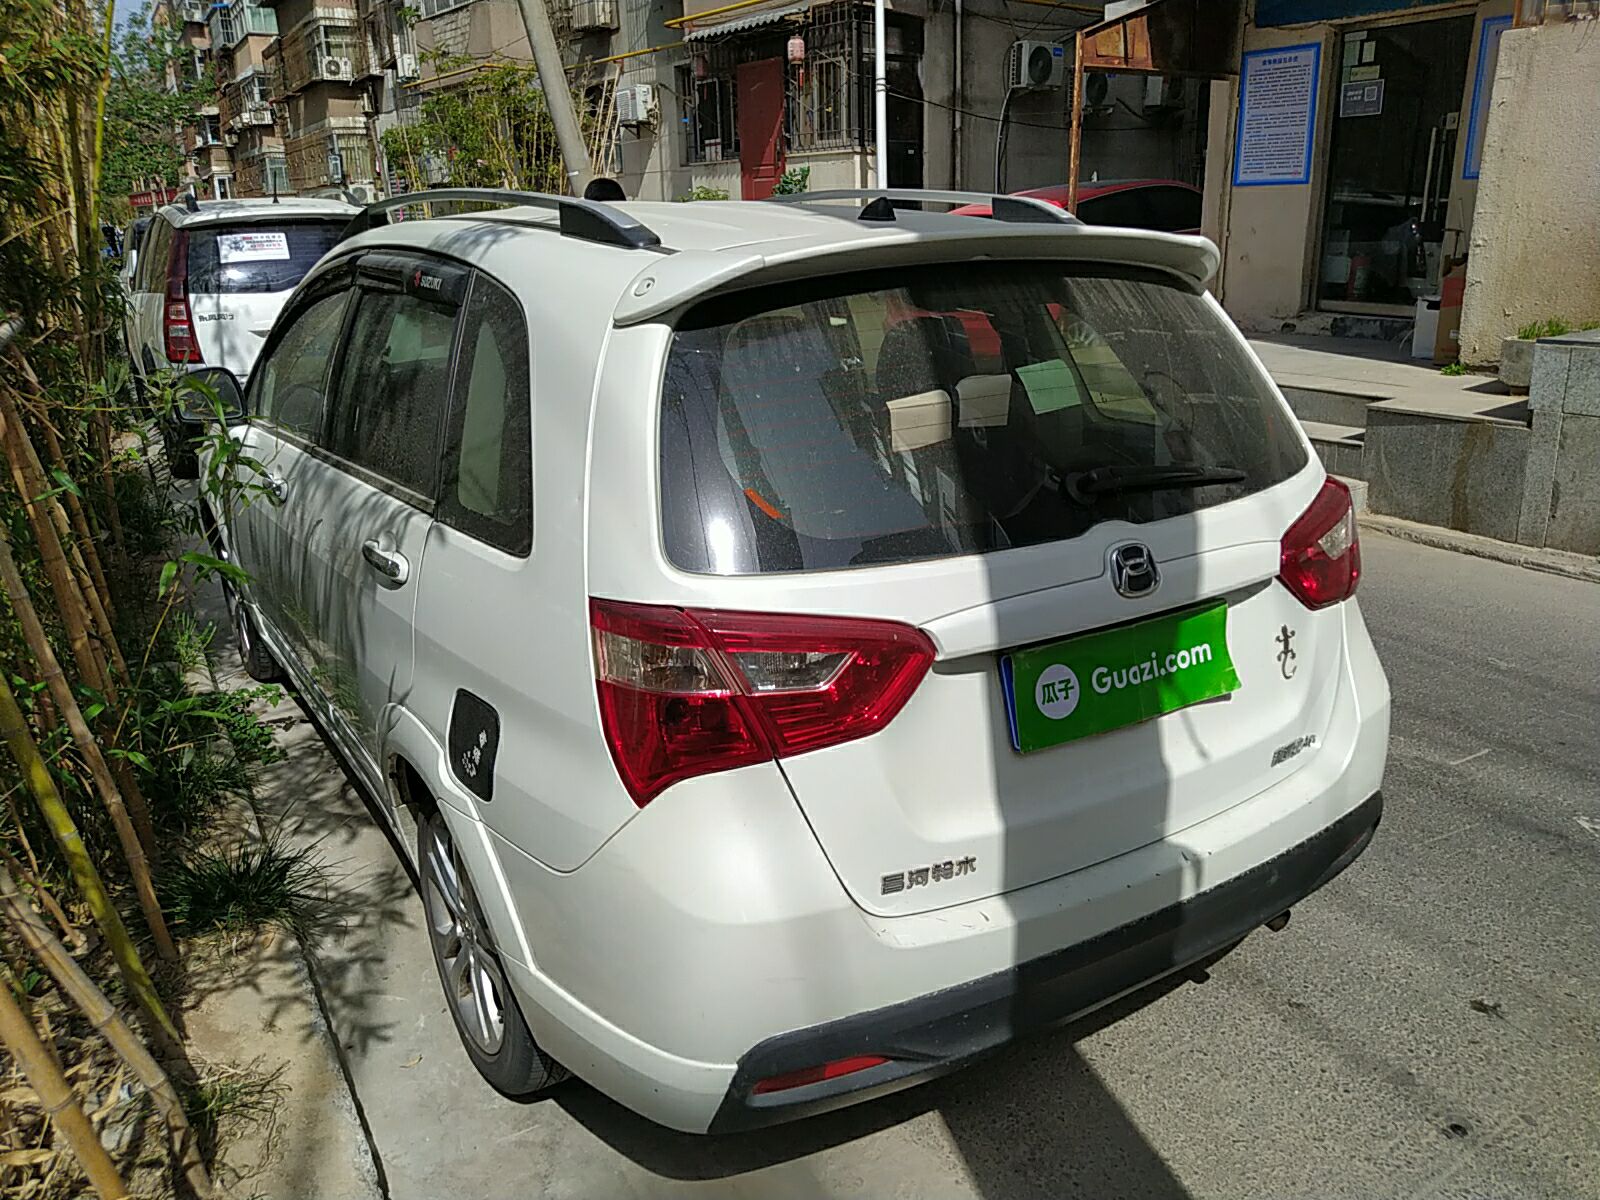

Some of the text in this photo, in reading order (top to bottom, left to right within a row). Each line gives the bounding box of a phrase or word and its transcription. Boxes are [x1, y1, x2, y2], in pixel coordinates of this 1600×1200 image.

[420, 275, 442, 290] SUZUKI
[1091, 643, 1213, 695] Guazi.com
[1041, 678, 1075, 705] 瓜子
[881, 856, 977, 895] 昌河铃木
